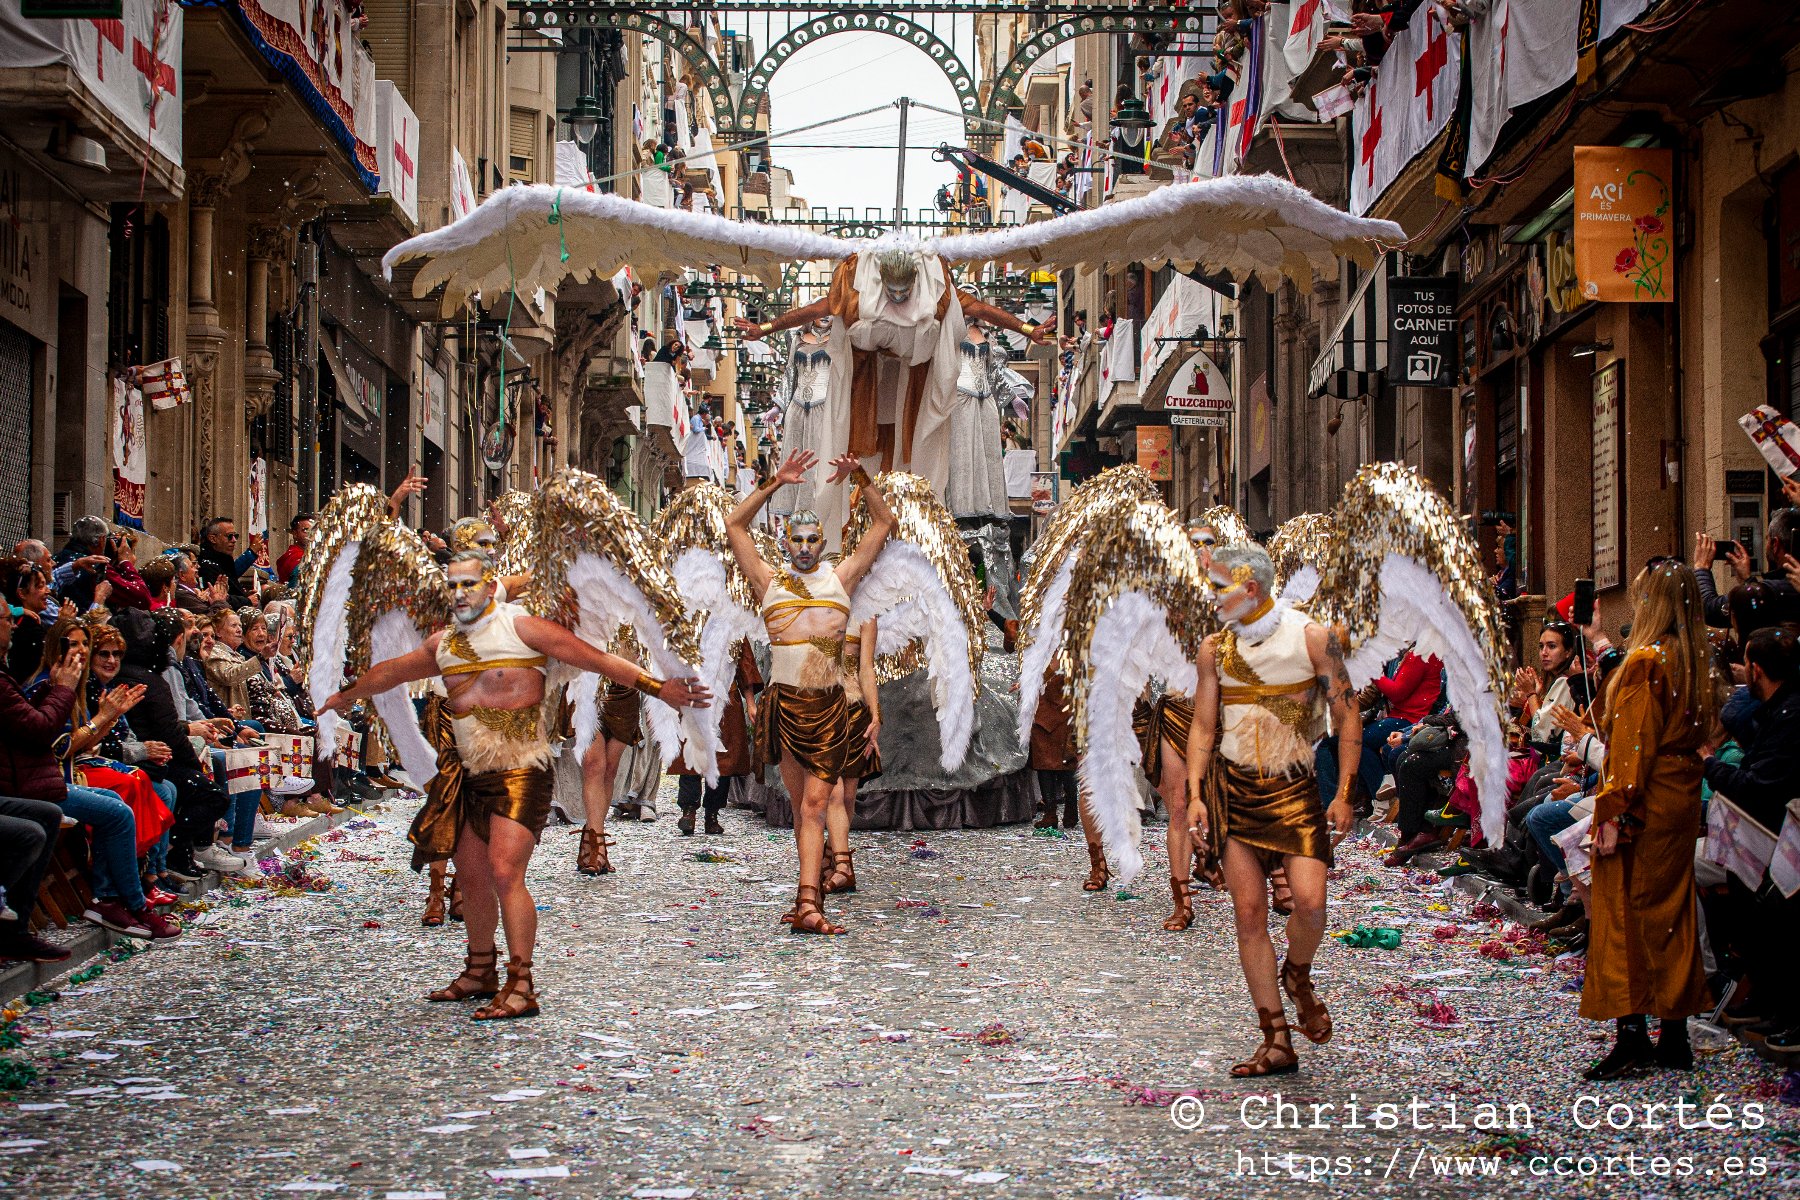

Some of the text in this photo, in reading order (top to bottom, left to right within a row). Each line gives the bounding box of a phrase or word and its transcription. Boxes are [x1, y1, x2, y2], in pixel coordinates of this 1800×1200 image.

[1580, 213, 1632, 222] PRIMAVERA
[1, 277, 31, 315] MODA
[1414, 291, 1435, 301] TUS
[1397, 304, 1452, 315] FOTOS DE
[1394, 317, 1458, 332] CARNET
[1410, 334, 1439, 345] AQUÍ
[1165, 395, 1232, 411] Cruzcampo
[1173, 416, 1205, 426] CAFETERÍA
